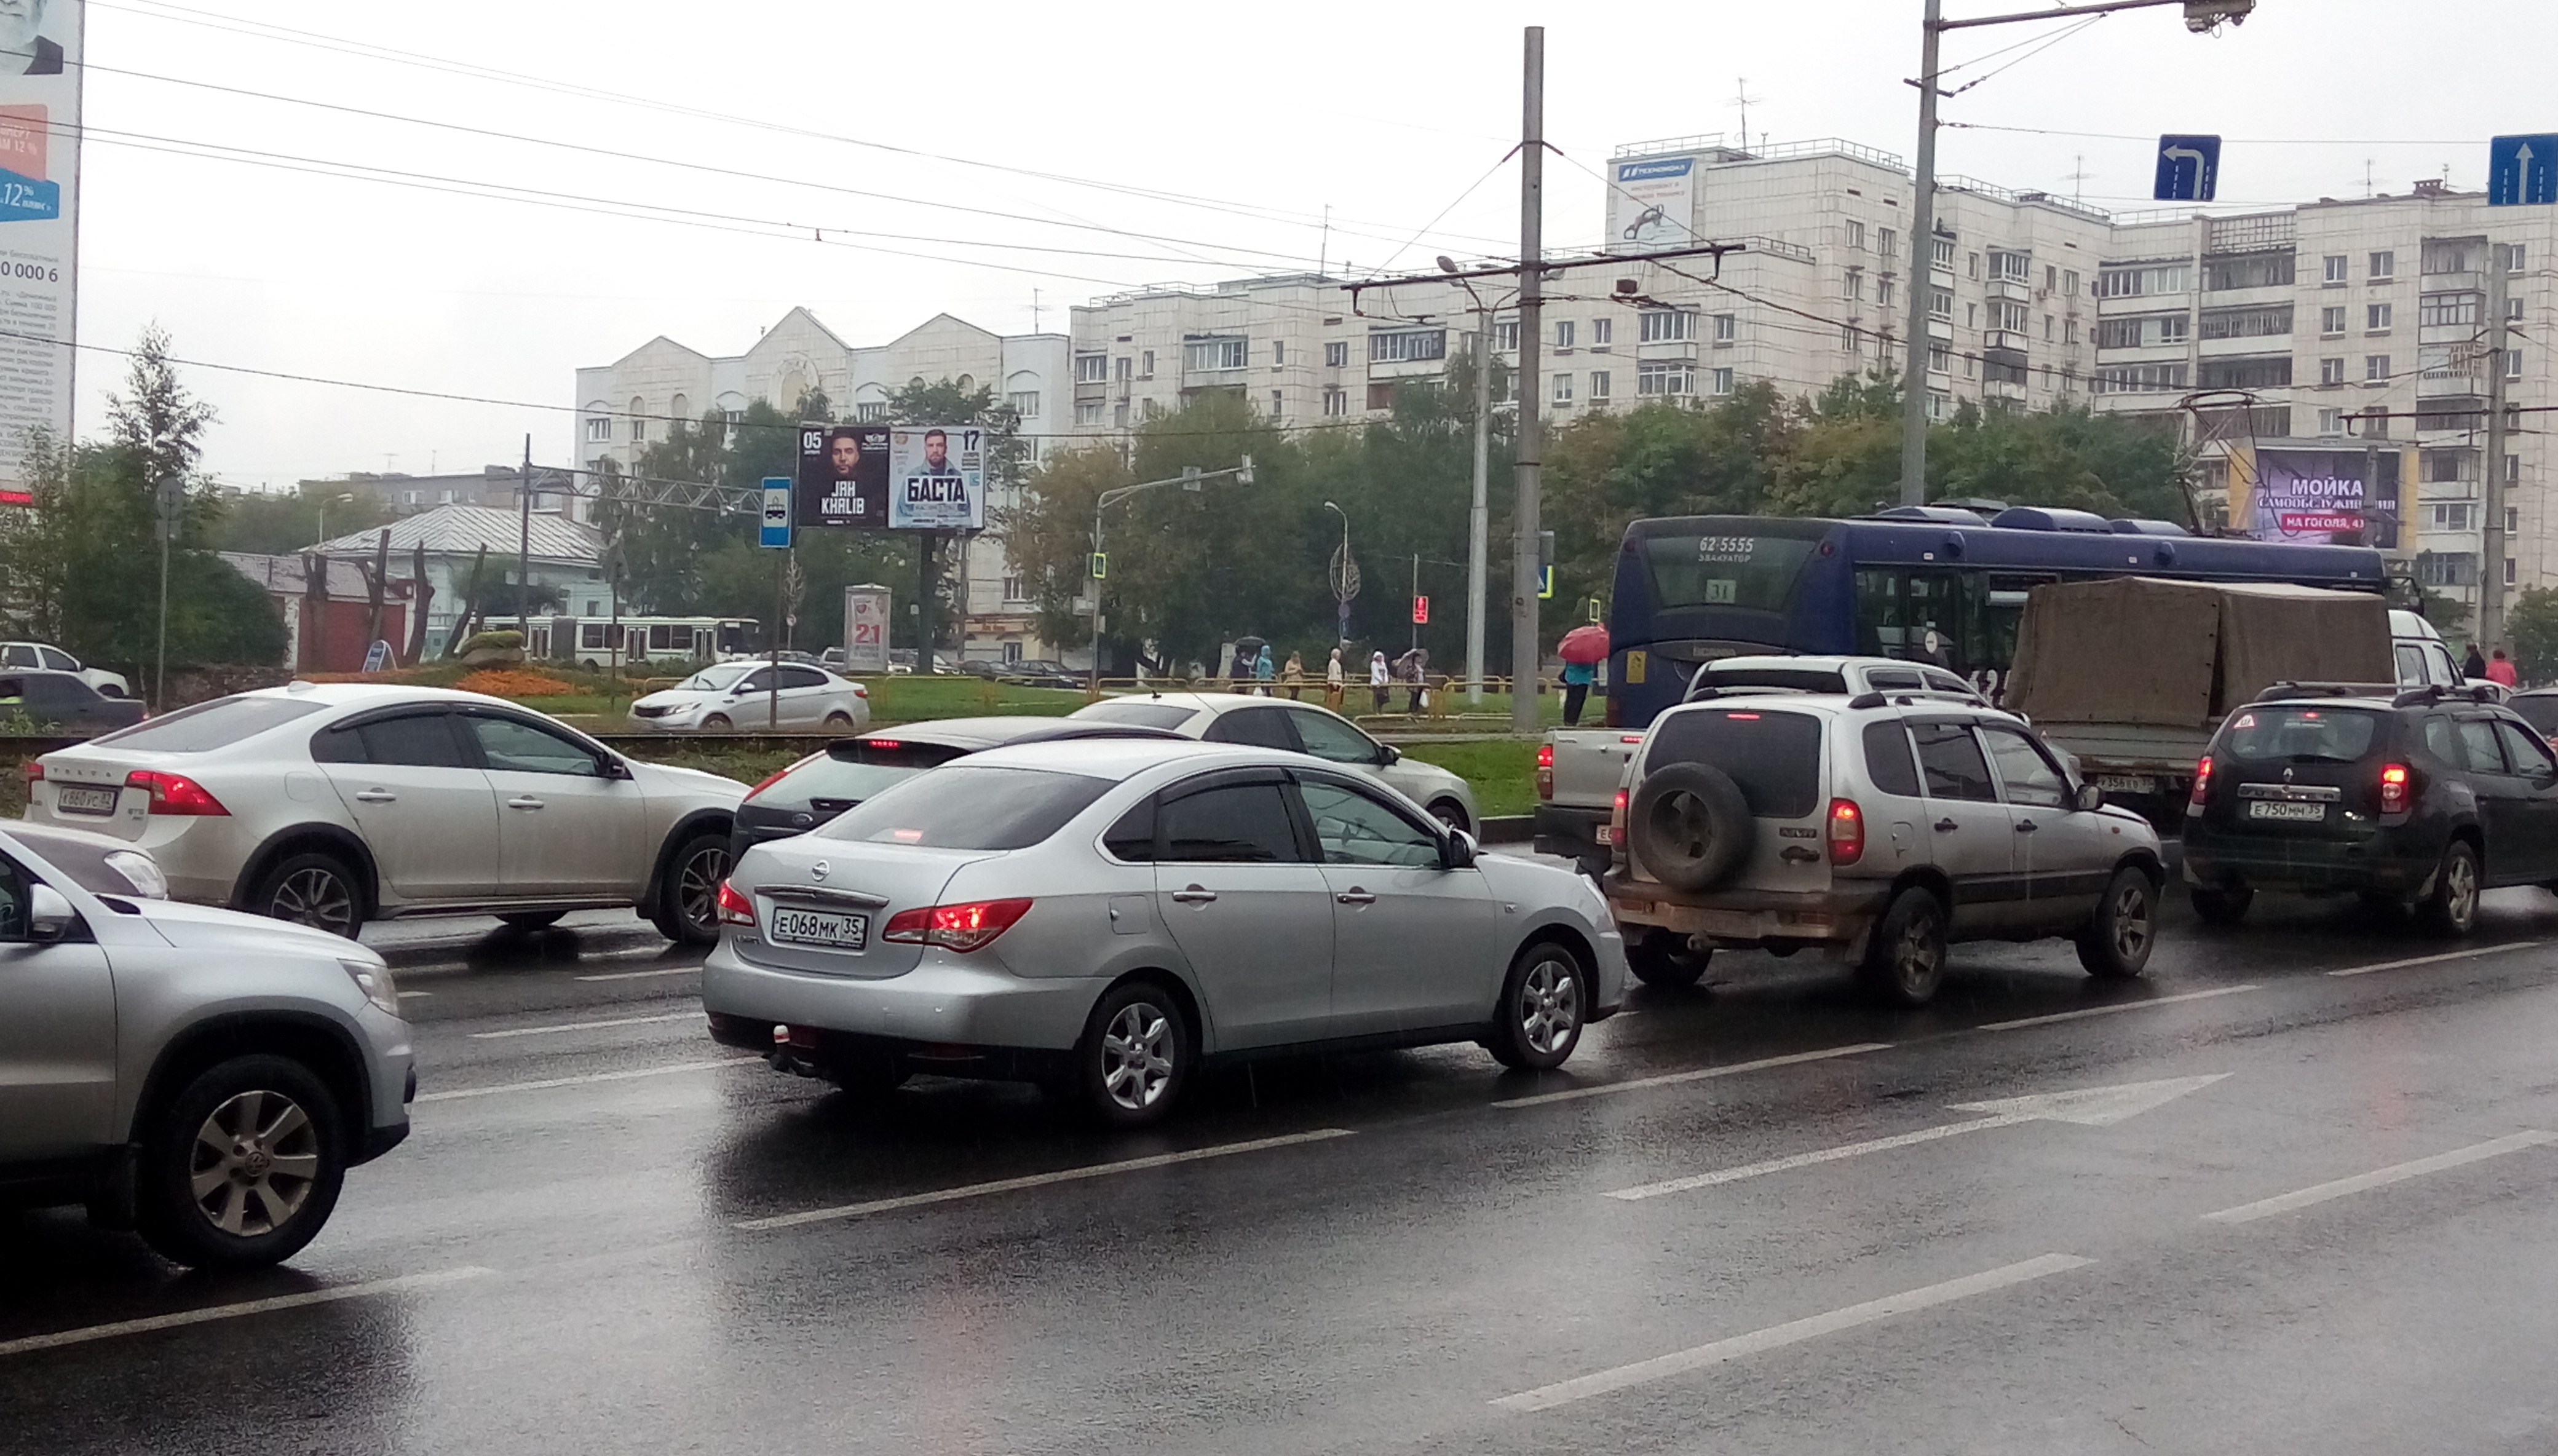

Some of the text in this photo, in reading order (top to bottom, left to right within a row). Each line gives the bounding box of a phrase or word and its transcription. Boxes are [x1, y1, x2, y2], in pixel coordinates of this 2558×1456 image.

[803, 432, 822, 449] 05
[964, 430, 980, 451] 17
[831, 481, 856, 497] JAH
[908, 478, 965, 502] БАСТА
[2291, 477, 2363, 496] МОЙКА
[822, 497, 865, 515] KHALIB
[2286, 516, 2302, 527] НА
[2305, 517, 2350, 529] ГОГОЛЯ,
[1698, 553, 1752, 563] ЭВАКУАТОР
[855, 623, 881, 644] 21
[779, 913, 839, 940] Е068МК
[843, 917, 860, 935] 35
